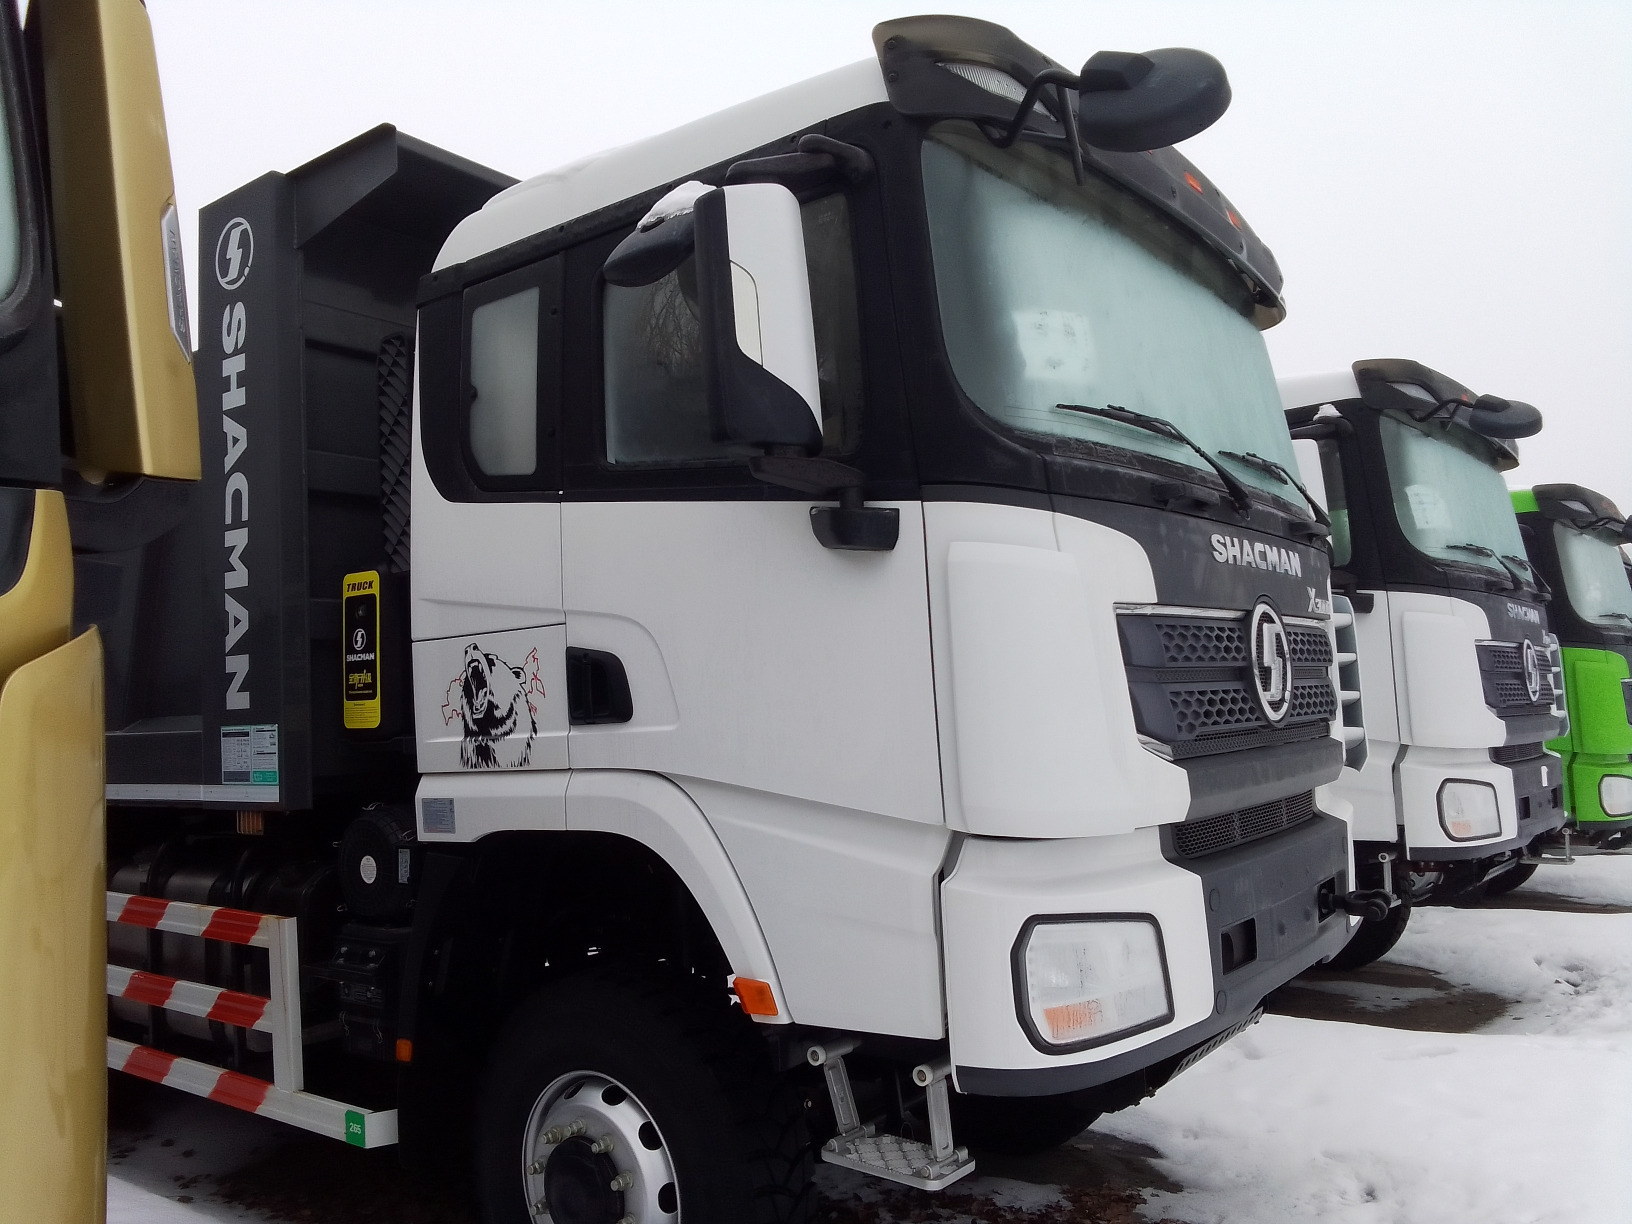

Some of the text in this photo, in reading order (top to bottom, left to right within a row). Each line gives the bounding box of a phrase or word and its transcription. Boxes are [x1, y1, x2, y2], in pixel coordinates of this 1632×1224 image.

[221, 302, 251, 711] SHACMAN
[1211, 533, 1302, 578] SHACMAN
[346, 580, 374, 593] TRUCK
[346, 652, 375, 662] SHACMAN
